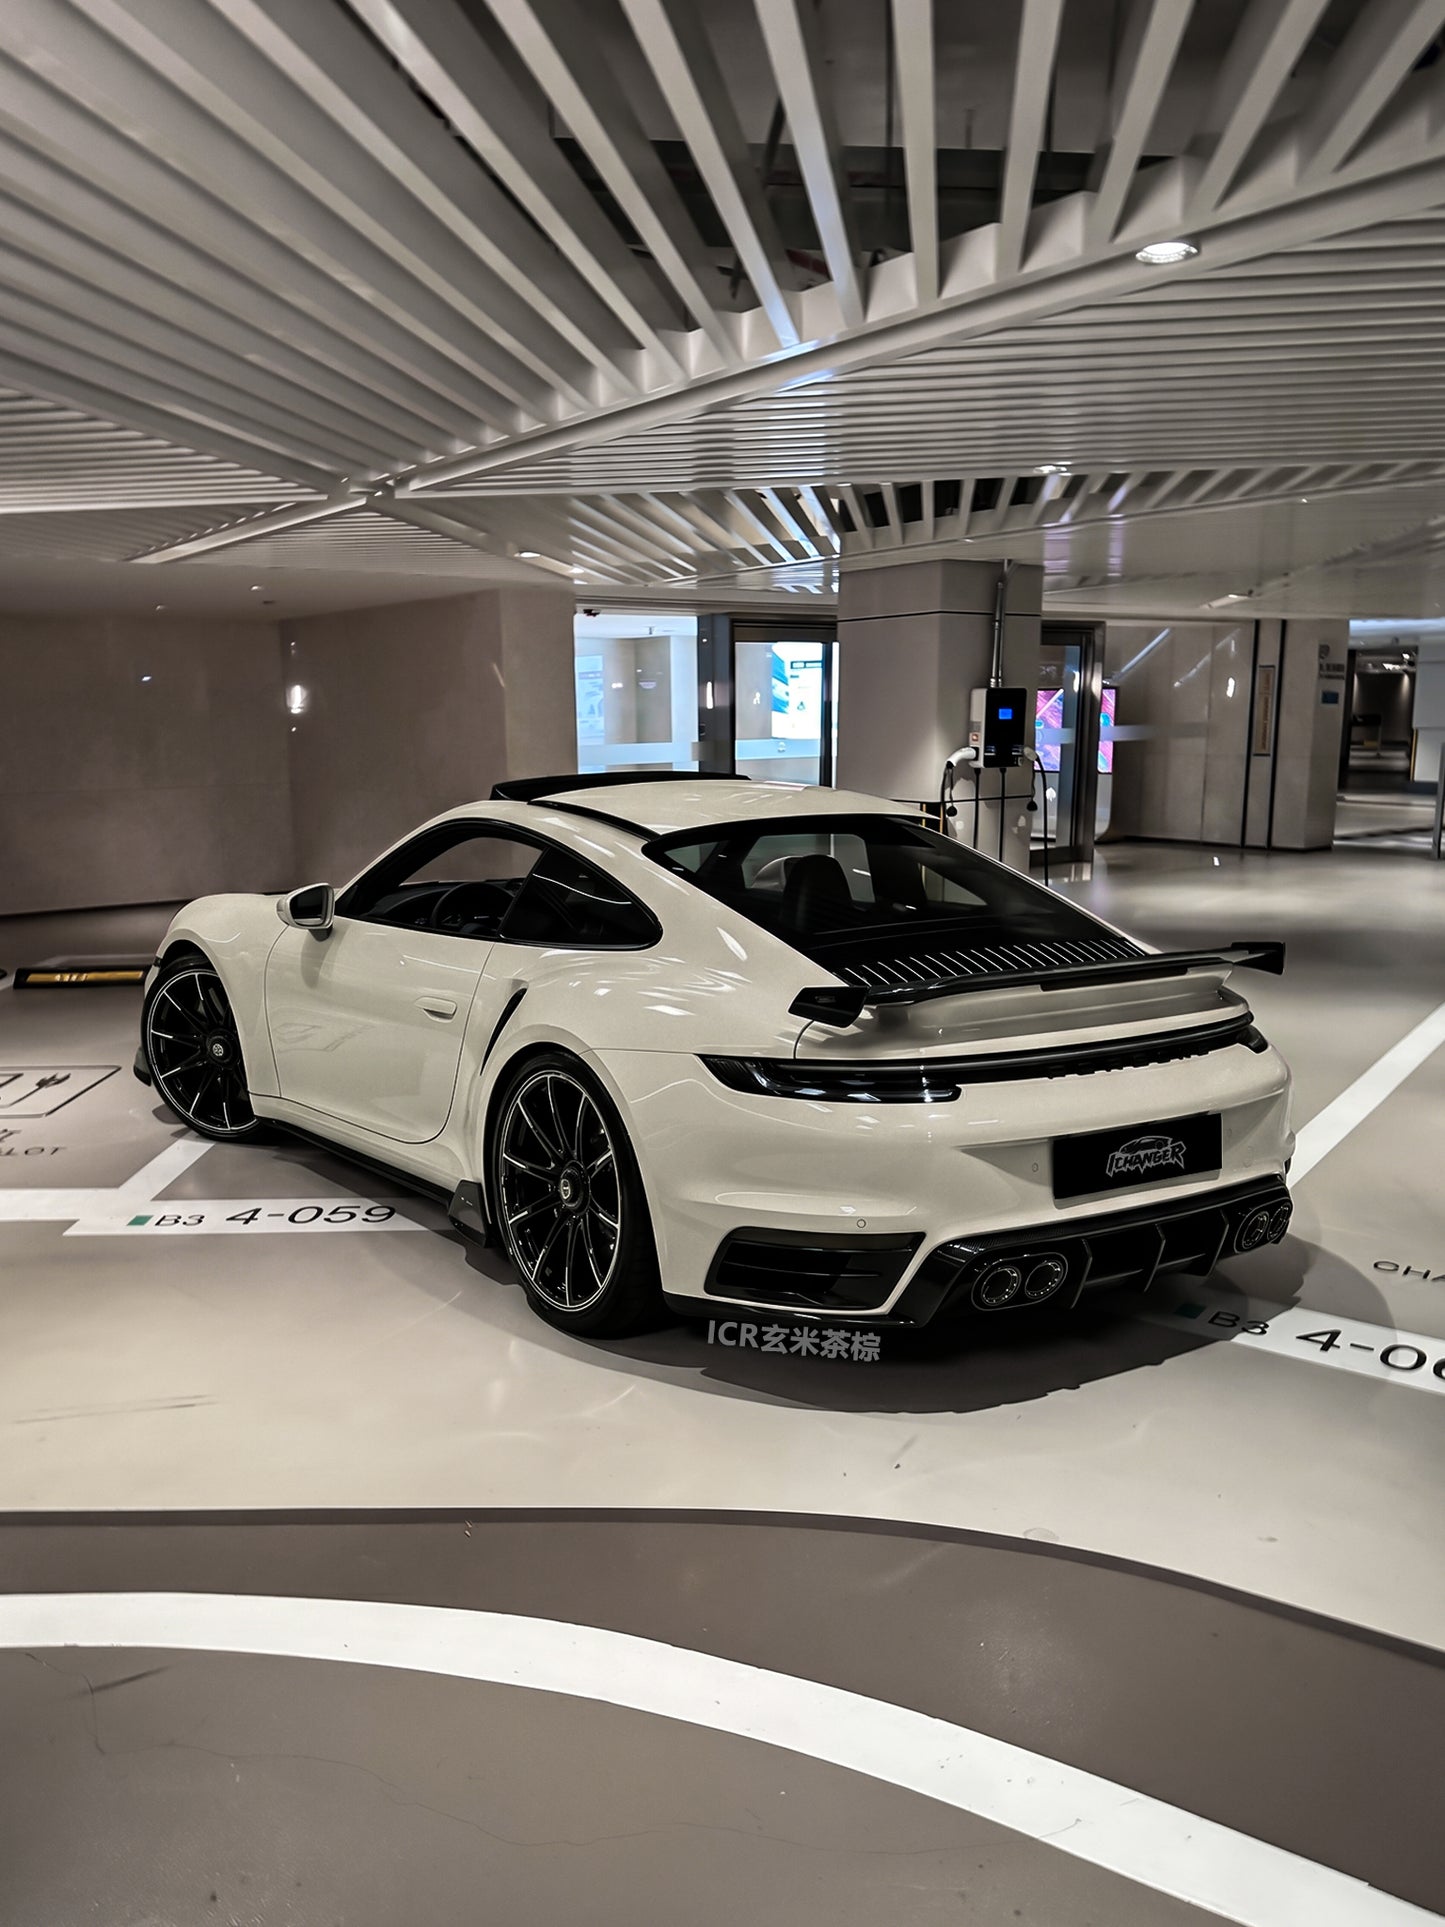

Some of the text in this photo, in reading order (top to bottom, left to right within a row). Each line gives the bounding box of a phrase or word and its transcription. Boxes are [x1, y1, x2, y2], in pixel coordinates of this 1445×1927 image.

[1105, 1140, 1187, 1178] ICHANGER
[154, 1205, 396, 1227] B3 4-059
[1208, 1311, 1445, 1380] B3 4-0
